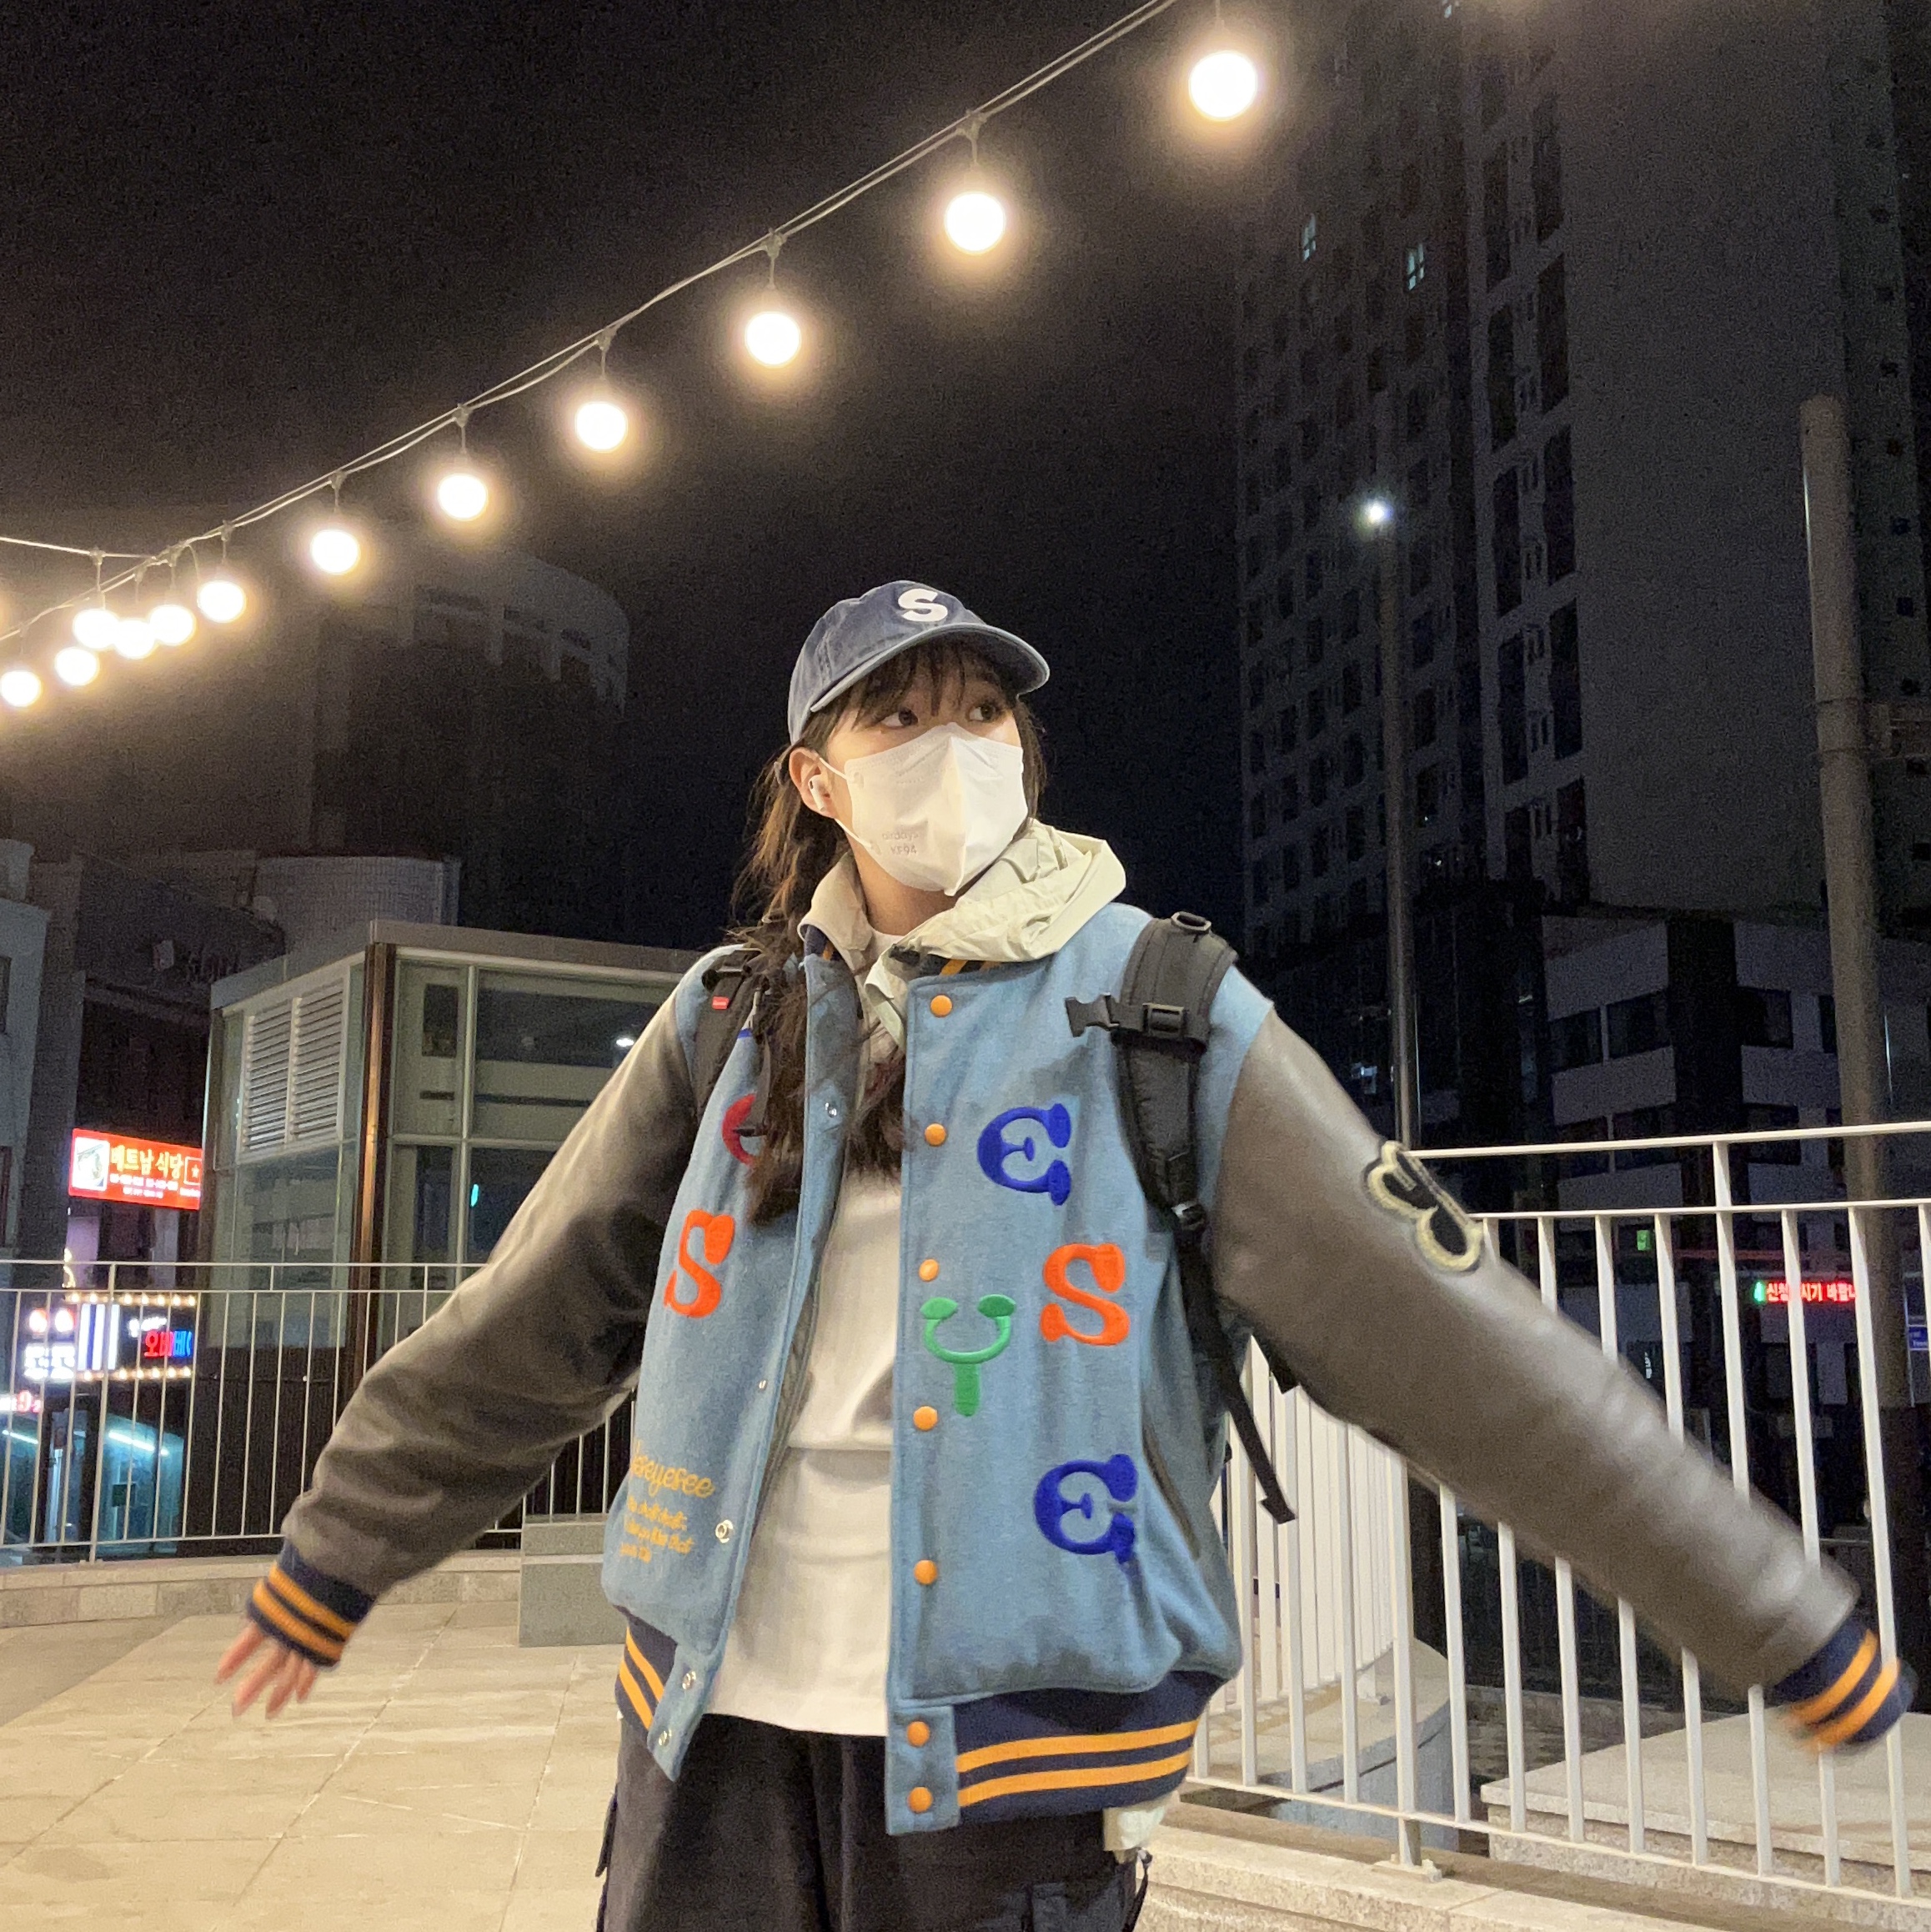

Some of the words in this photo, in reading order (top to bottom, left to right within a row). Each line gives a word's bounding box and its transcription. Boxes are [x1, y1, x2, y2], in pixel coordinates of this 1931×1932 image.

[898, 588, 948, 622] S
[155, 1151, 184, 1180] 식당
[977, 1103, 1072, 1206] E
[664, 1210, 735, 1317] S
[1040, 1243, 1130, 1346] S
[920, 1294, 1017, 1418] Y
[1034, 1453, 1138, 1564] E
